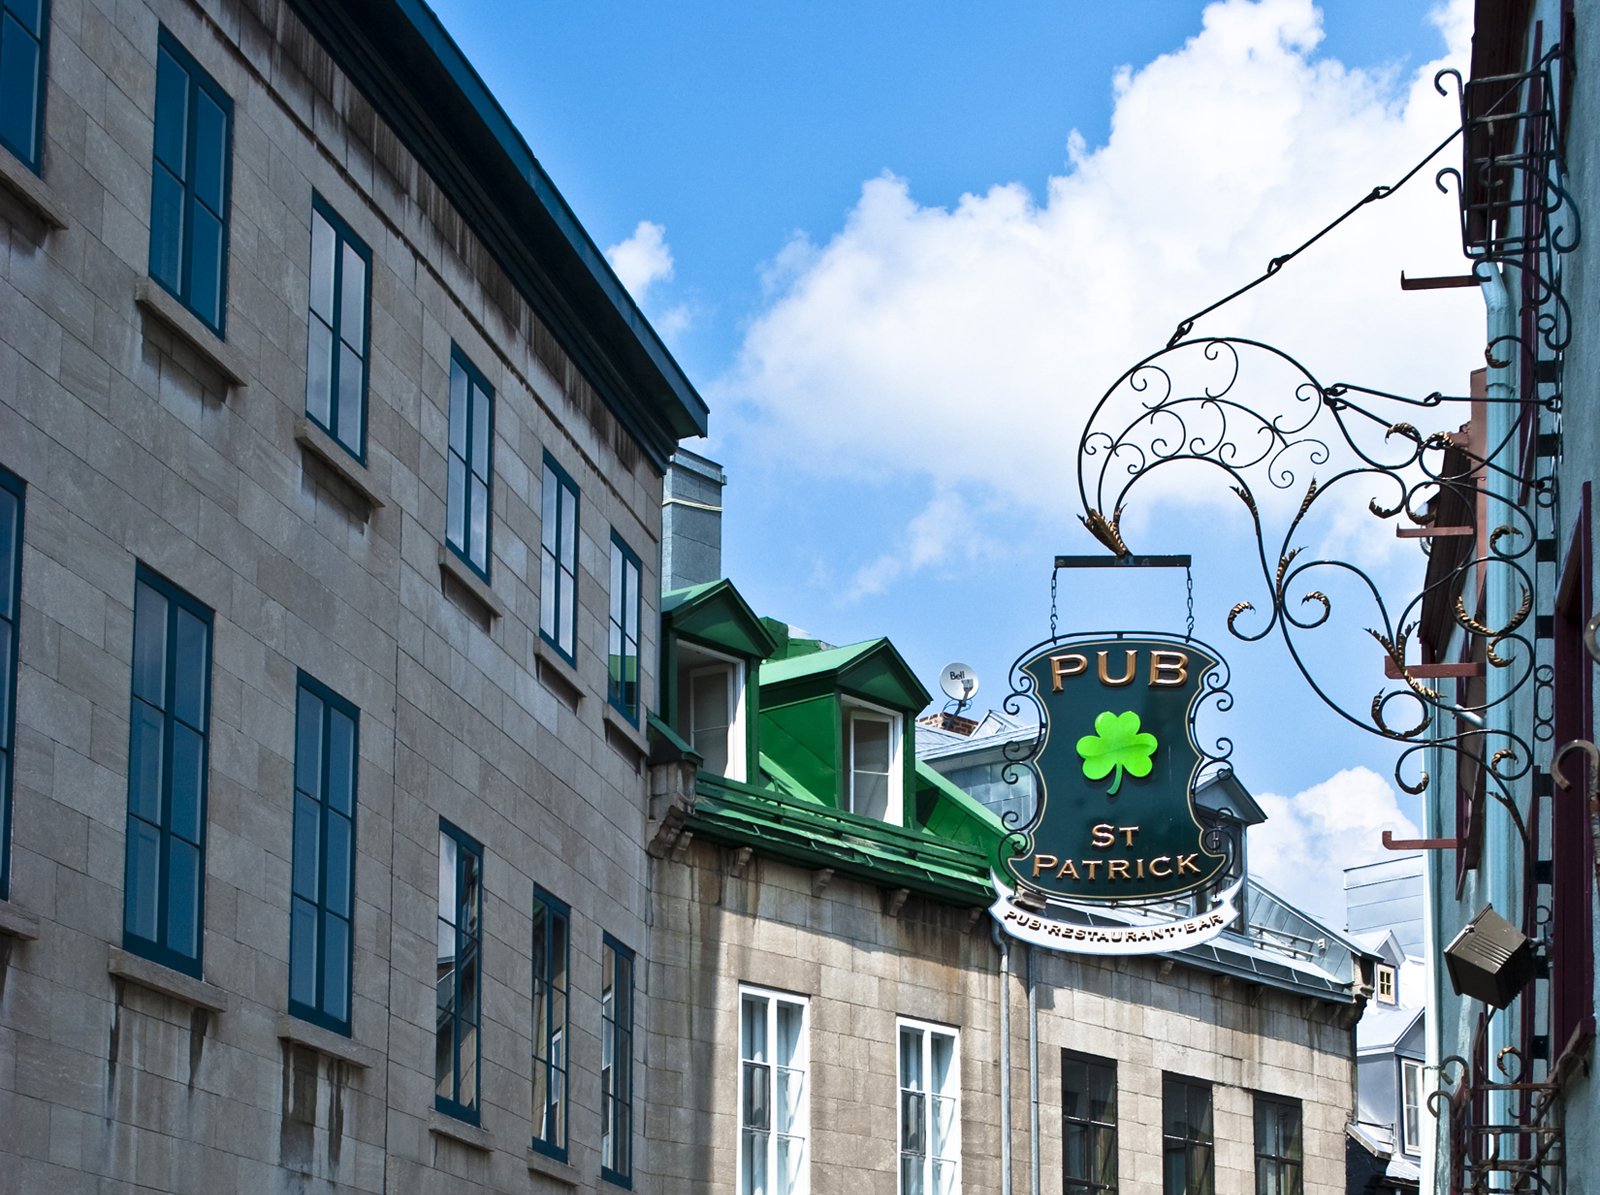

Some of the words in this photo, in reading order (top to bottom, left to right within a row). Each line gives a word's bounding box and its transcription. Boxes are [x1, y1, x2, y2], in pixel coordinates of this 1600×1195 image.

[950, 671, 965, 680] Bell
[1049, 649, 1189, 692] PUB
[1091, 823, 1140, 848] ST
[1032, 853, 1201, 881] PATRICK
[1003, 910, 1042, 931] PUB
[1046, 924, 1176, 943] RESTAURANT
[1184, 914, 1224, 934] BAR
